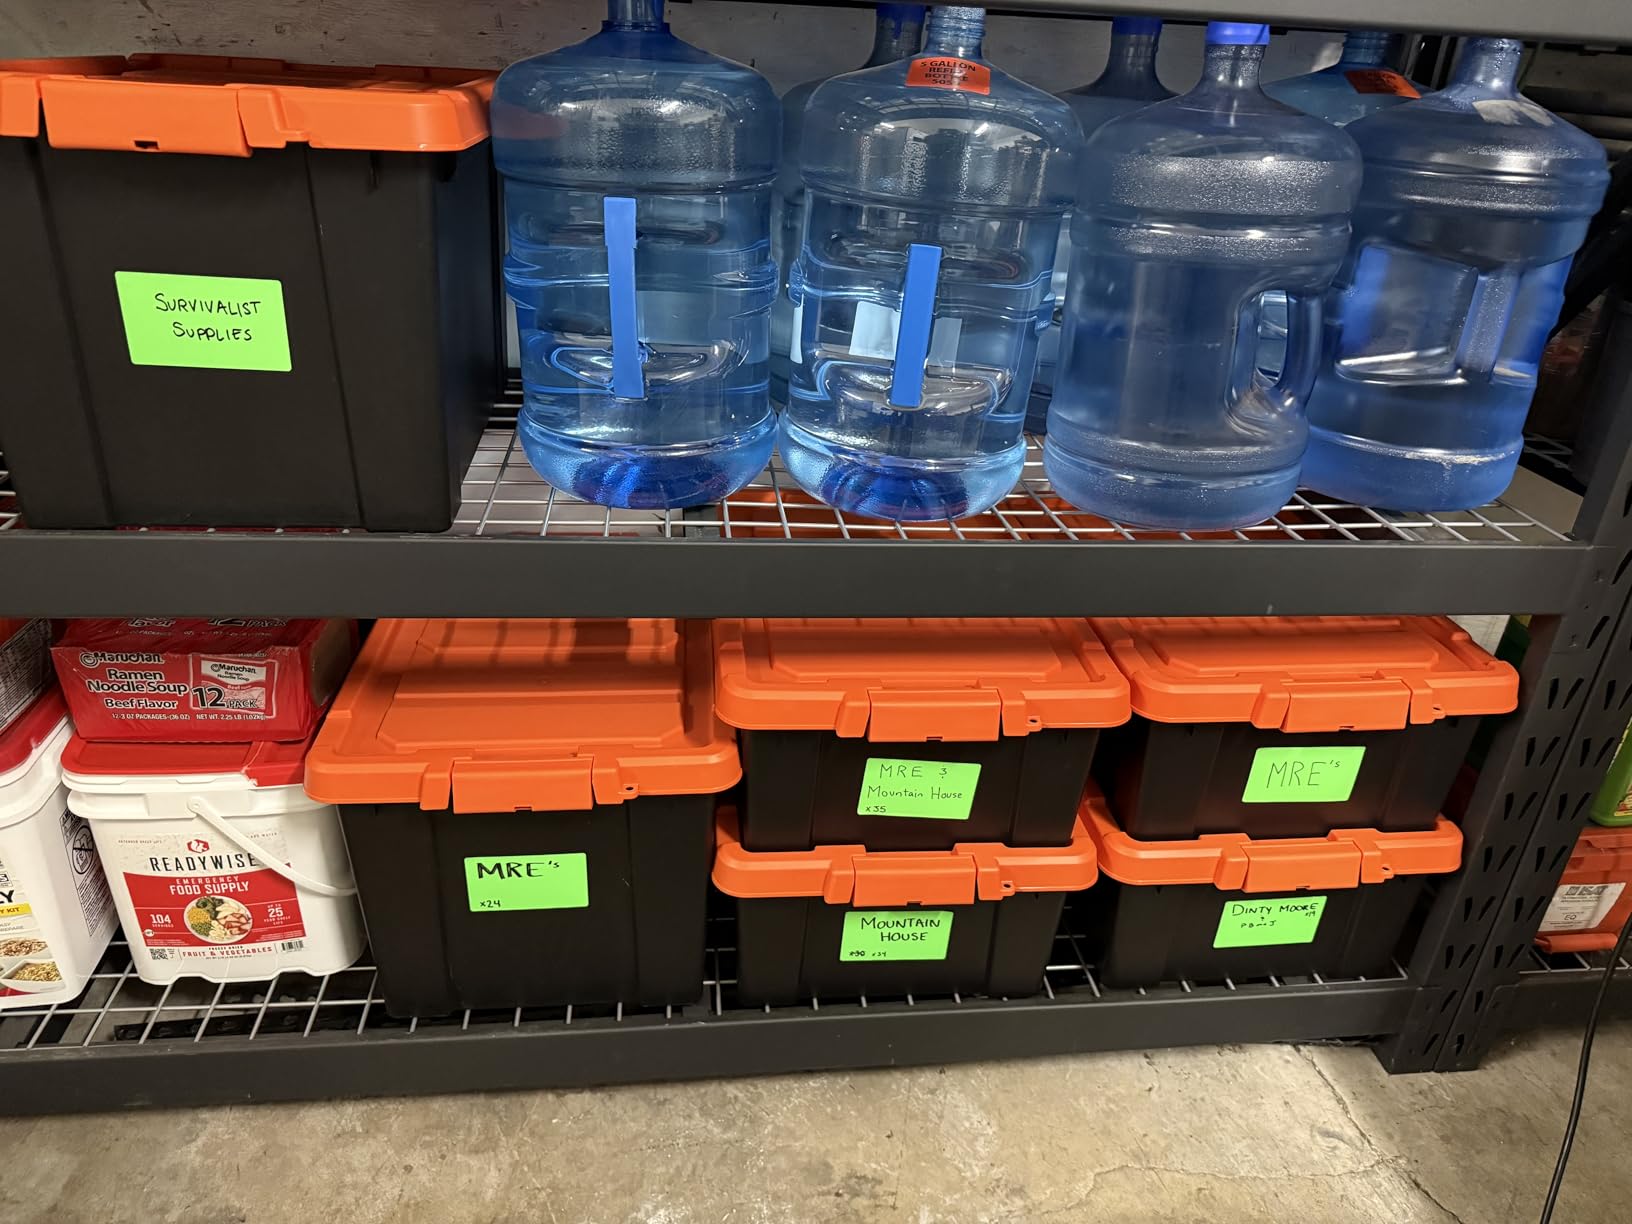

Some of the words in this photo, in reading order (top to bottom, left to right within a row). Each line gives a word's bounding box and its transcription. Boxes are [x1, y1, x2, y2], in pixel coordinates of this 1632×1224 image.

[928, 66, 964, 74] REFI
[924, 73, 969, 82] BOTTE
[154, 292, 261, 318] SURVIVALIST
[172, 321, 253, 342] SUPPLIES
[94, 652, 164, 665] Maruchan
[106, 668, 164, 681] Ramen
[219, 663, 256, 676] Maruchan
[86, 680, 147, 694] Noodle
[147, 681, 189, 697] Soup
[104, 698, 136, 709] Beef
[137, 699, 178, 709] Flavor
[192, 686, 226, 709] 12
[229, 699, 258, 709] PACK
[879, 763, 924, 779] MRE
[1266, 761, 1341, 789] MRE's
[867, 785, 924, 800] Mountain
[930, 786, 963, 800] House
[149, 852, 259, 872] READYWISE
[476, 860, 560, 880] MRE's
[175, 875, 240, 885] EMERGENCY
[169, 883, 201, 896] FOOD
[205, 880, 250, 895] SUPPLY
[267, 907, 284, 918] 25
[1232, 903, 1273, 916] DINTY
[1279, 902, 1320, 913] MOORE
[150, 913, 171, 924] 104
[860, 916, 941, 930] MOUNTAIN
[880, 931, 929, 942] HOUSE
[219, 946, 272, 956] VEGETABLES
